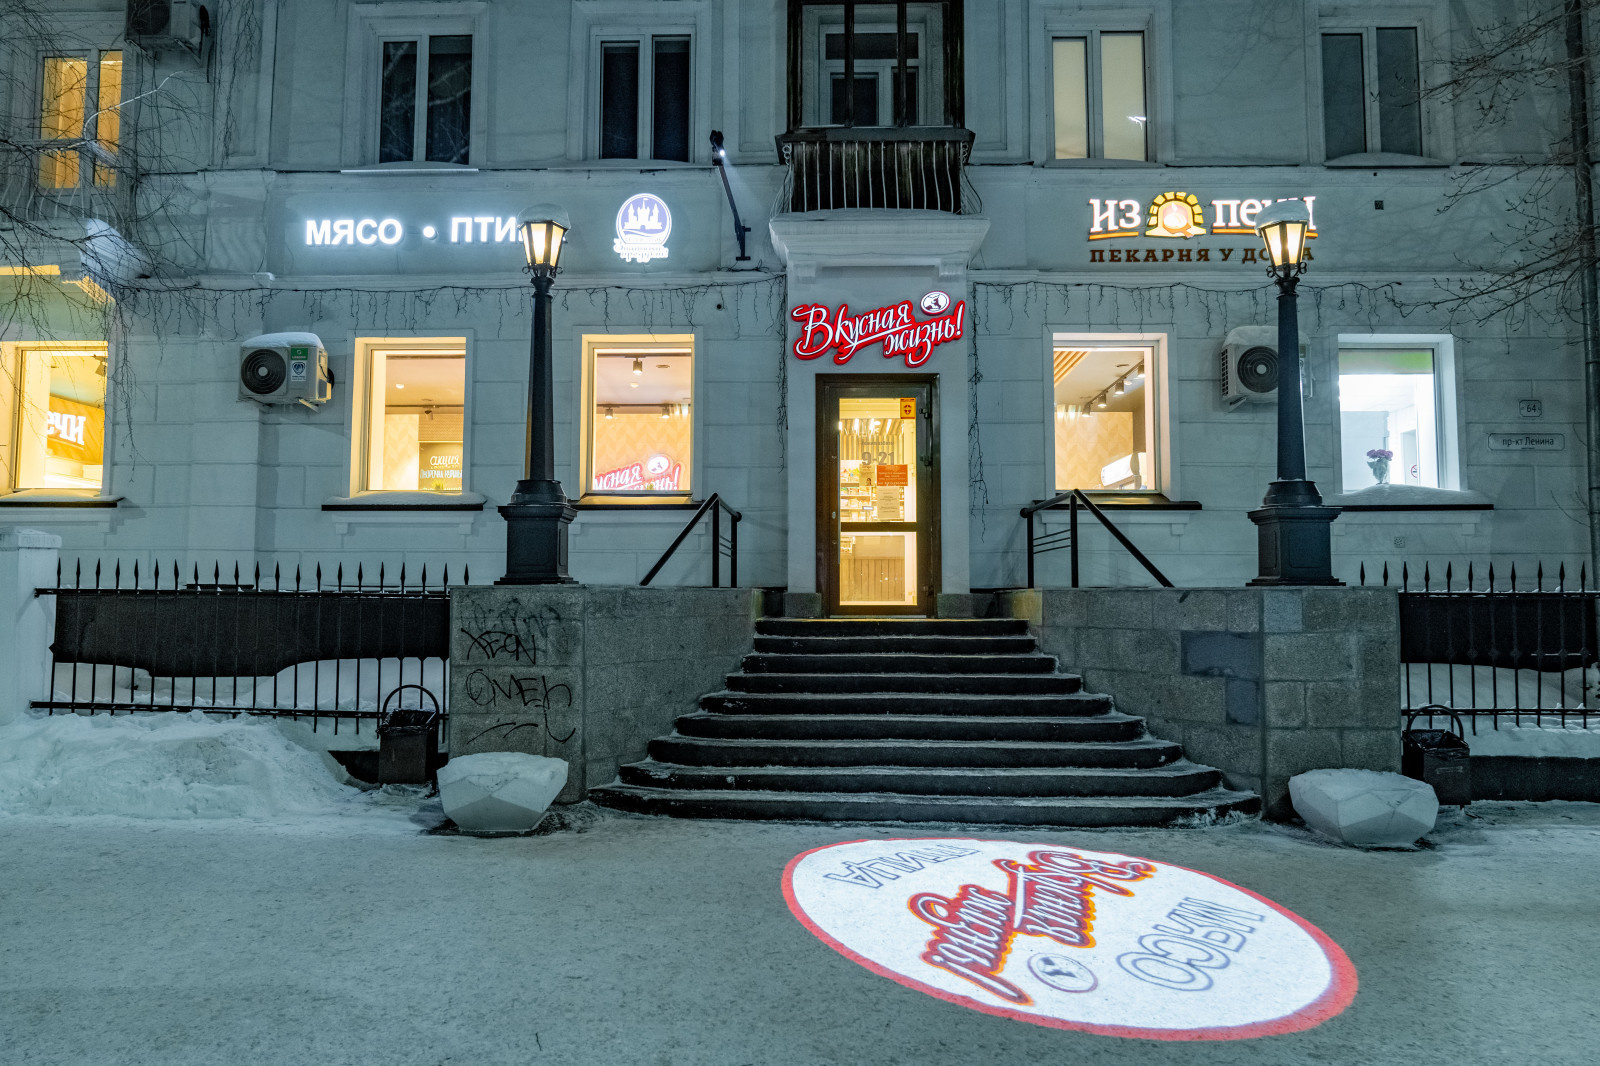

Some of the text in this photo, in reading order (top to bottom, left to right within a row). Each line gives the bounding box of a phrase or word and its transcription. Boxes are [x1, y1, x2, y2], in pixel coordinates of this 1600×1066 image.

[305, 218, 402, 245] МЯСО
[1089, 247, 1315, 264] ПЕКАРНЯ У ДОА
[792, 302, 914, 362] Вкусная
[884, 303, 964, 365] жизнь!
[1526, 404, 1536, 413] 64
[1502, 436, 1555, 447] пр-кт Ленина
[861, 451, 895, 466] 9-21
[822, 844, 981, 889] ПТИЦА
[1115, 896, 1266, 992] МЯСО
